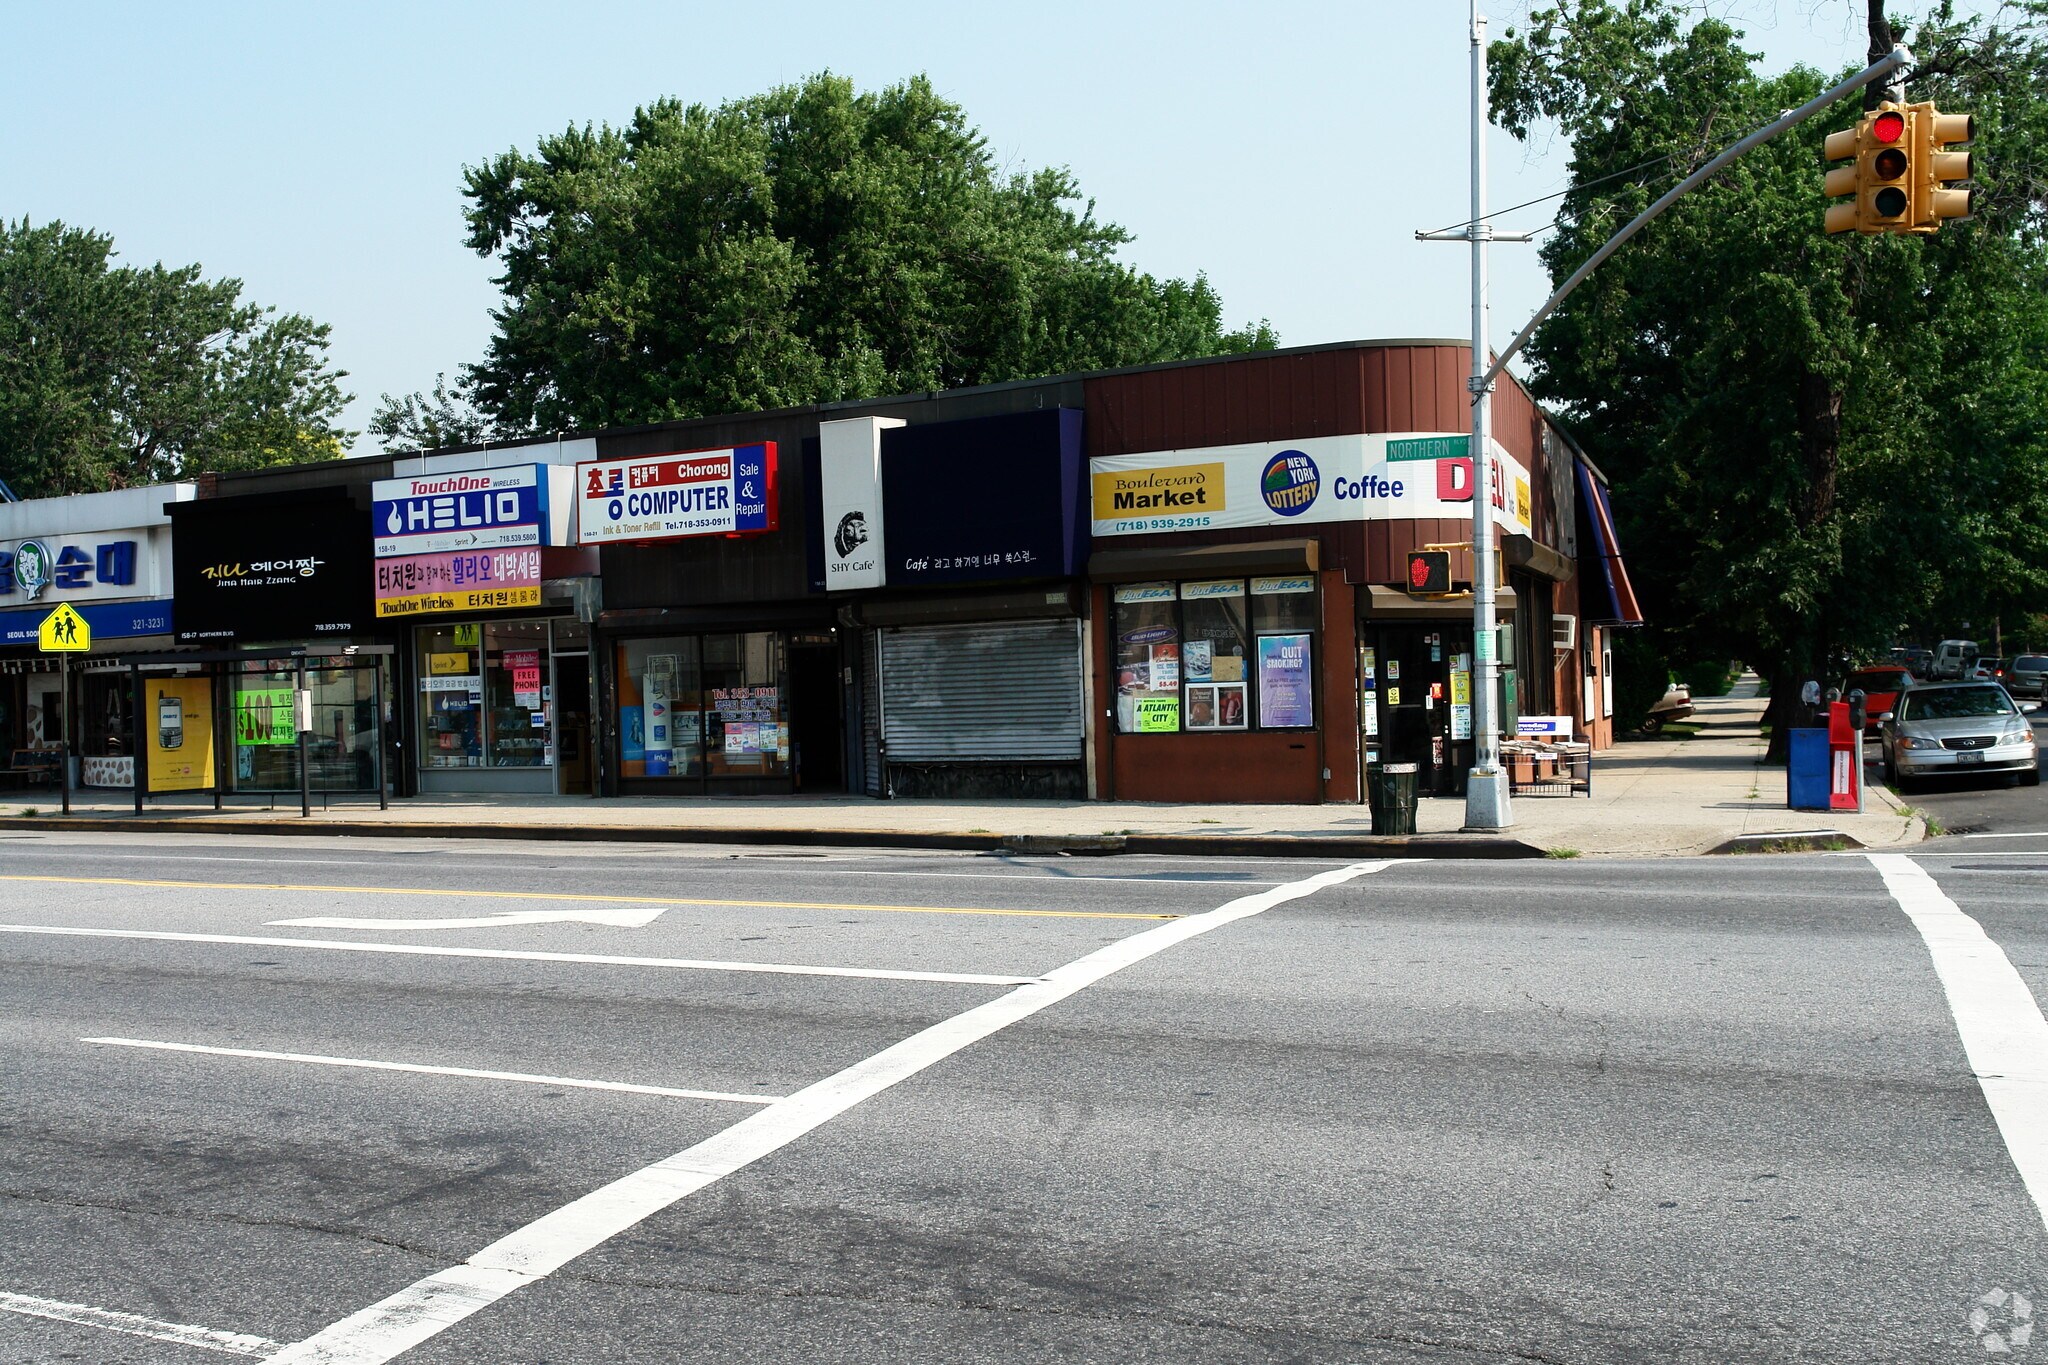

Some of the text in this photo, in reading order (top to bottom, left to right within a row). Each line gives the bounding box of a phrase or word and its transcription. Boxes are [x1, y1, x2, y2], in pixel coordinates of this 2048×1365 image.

[1389, 439, 1450, 459] NORTHERN
[677, 461, 729, 479] Chorong
[739, 463, 759, 478] Sale
[1286, 456, 1309, 469] NEW
[631, 465, 660, 487] 컴퓨터
[1115, 472, 1206, 490] Boulevard
[1289, 467, 1317, 485] YORK
[410, 476, 521, 496] TouchOne WIRELESS
[586, 467, 625, 521] 초롱
[741, 480, 758, 499] &
[1333, 475, 1404, 500] Coffee
[627, 485, 730, 517] COMPUTER
[1113, 486, 1207, 510] Market
[1266, 480, 1318, 509] LOTTERY
[406, 491, 520, 531] HELIO
[735, 501, 765, 518] Repair
[602, 525, 615, 536] Ink
[623, 522, 642, 533] Toner
[643, 521, 661, 532] Refill
[1115, 516, 1211, 532] (718) 939-2915
[454, 538, 469, 547] Sprint
[499, 533, 537, 544] 718.539.5800
[378, 544, 397, 553] 158-19
[54, 544, 136, 588] 순대
[452, 555, 492, 585] 힐리오
[493, 550, 540, 582] 대박세일
[831, 562, 851, 573] SHY
[934, 558, 951, 569] 라고
[983, 552, 1001, 566] 너무
[381, 594, 454, 615] TouchOne Wireless
[468, 591, 508, 607] 터치원
[132, 617, 165, 630] 321-3231
[314, 623, 352, 631] 718.359.7979
[7, 630, 26, 639] SEOUL
[1281, 646, 1303, 659] QUIT
[1266, 658, 1303, 669] SMOKING?
[517, 670, 536, 680] FREE
[514, 680, 539, 690] PHONE
[712, 687, 778, 700] Tel. 353-0911
[1143, 703, 1179, 712] ATLANTIC
[1152, 713, 1169, 723] CITY
